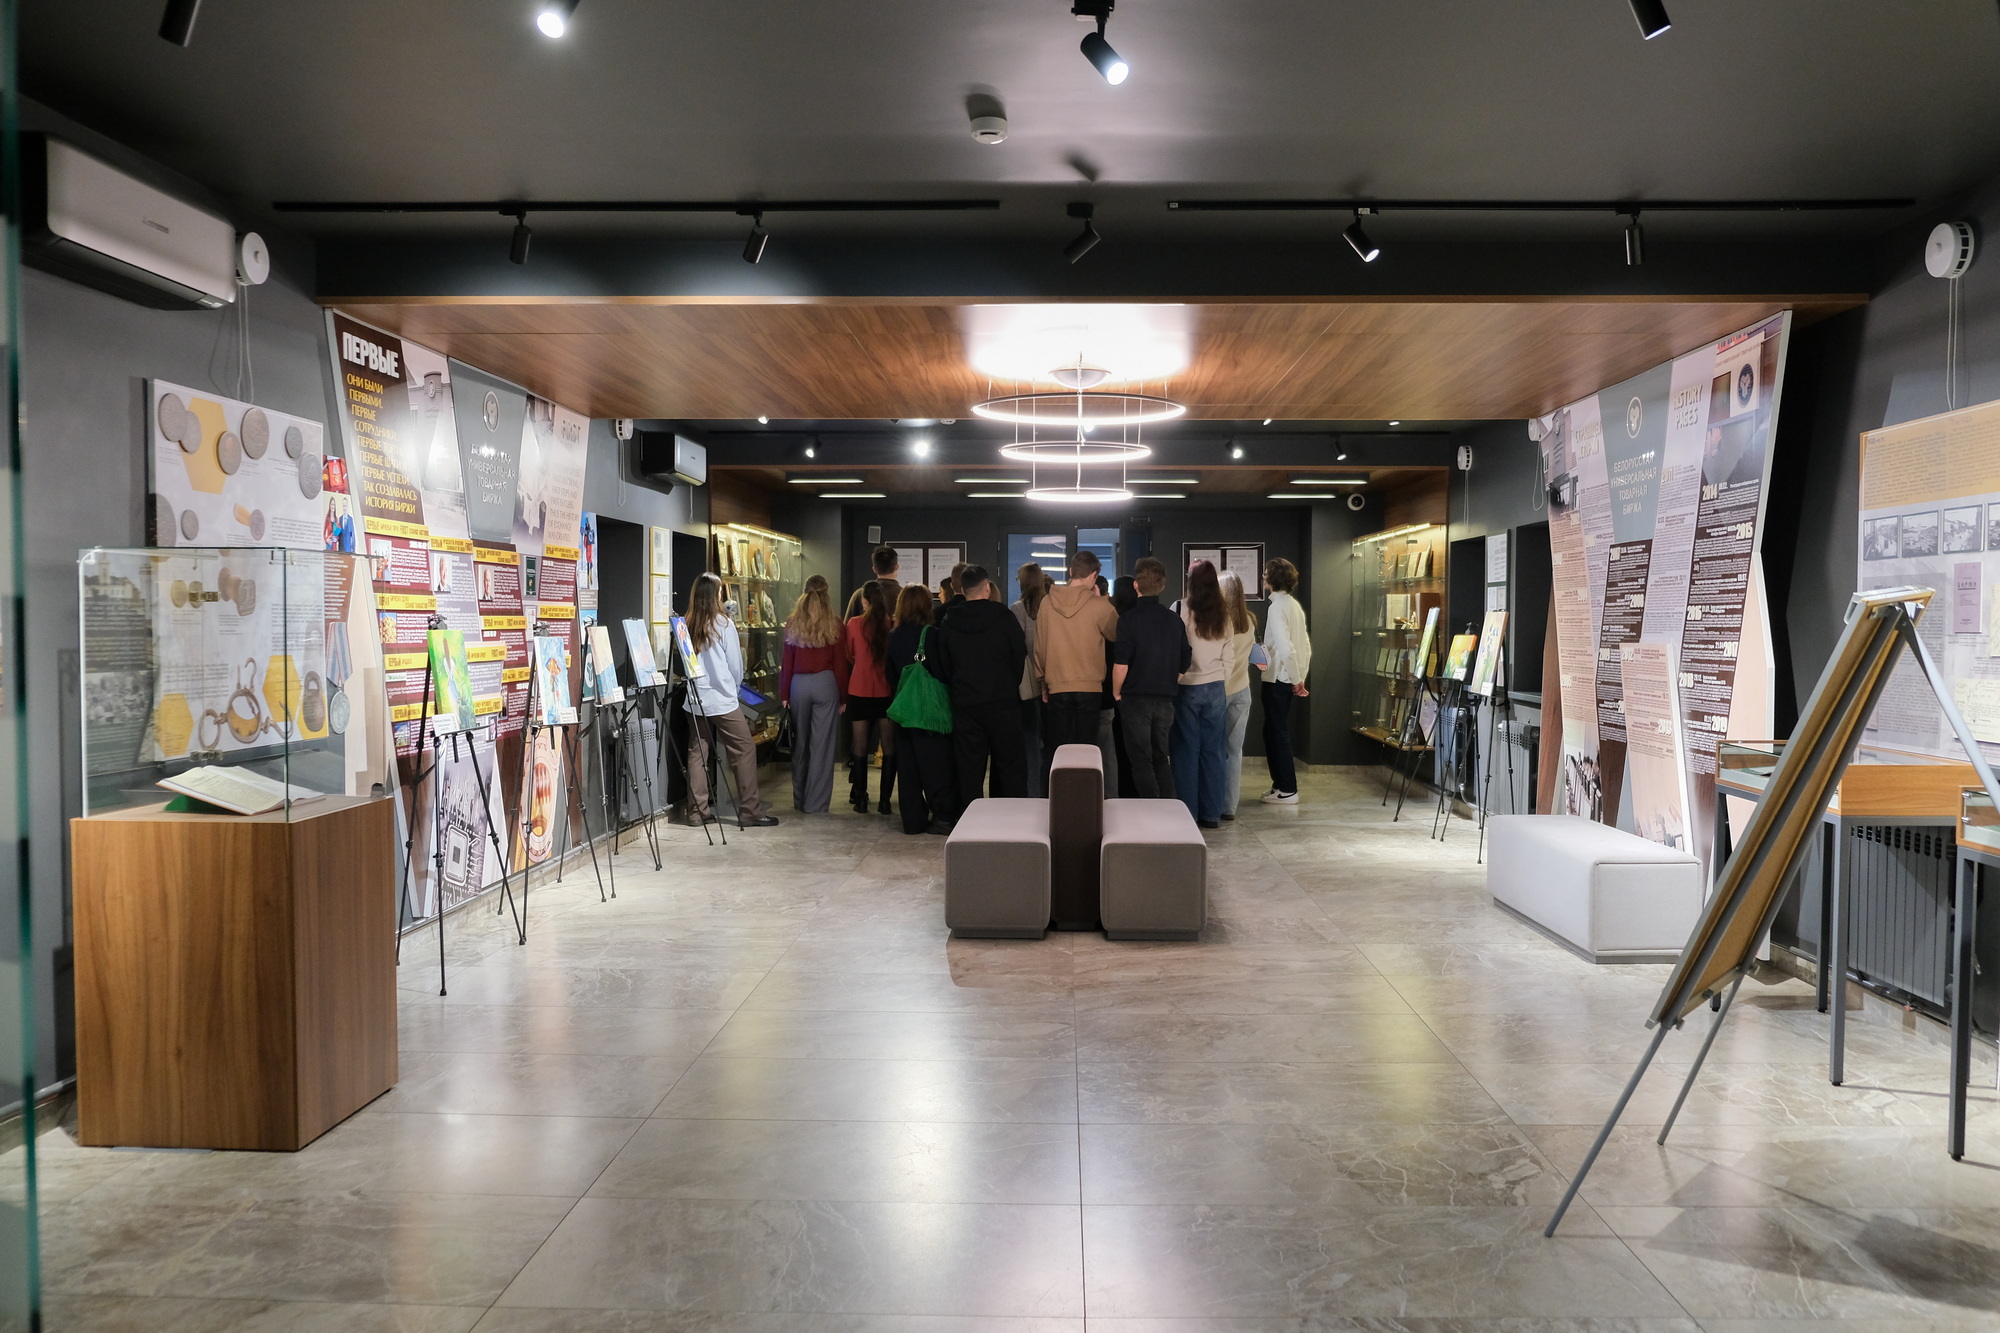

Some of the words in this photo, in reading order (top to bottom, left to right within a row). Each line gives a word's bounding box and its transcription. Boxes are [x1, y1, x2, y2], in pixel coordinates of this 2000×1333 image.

[343, 332, 399, 378] ПЕРВЫЕ
[347, 373, 363, 389] ОНИ
[365, 379, 383, 394] БЫЛИ
[1673, 384, 1704, 411] HISTORY
[352, 404, 376, 421] ПЕРВЫЕ
[1675, 407, 1699, 431] PAGES
[357, 435, 382, 451] ПЕРВЫЕ
[360, 450, 383, 466] ПЕРВЫЕ
[1613, 451, 1655, 473] БЕЛОРУССКАЯ
[361, 465, 385, 480] ПЕРВЫЕ
[467, 458, 516, 479] УНИВЕРСАЛЬНАЯ
[1610, 466, 1658, 489] УНИВЕРСАЛЬНАЯ
[363, 480, 375, 493] ТАК
[375, 482, 418, 501] СОЗДАВАЛАСЬ
[482, 491, 502, 506] БИРЖА
[1618, 484, 1648, 501] ТОВАРНАЯ
[1702, 483, 1718, 501] 2014
[365, 495, 395, 511] ИСТОРИЯ
[395, 499, 416, 514] БИРЖИ
[1622, 501, 1643, 516] БИРЖА
[1735, 521, 1753, 540] 2015
[1723, 641, 1739, 657] 2017
[1711, 715, 1728, 733] 2019
